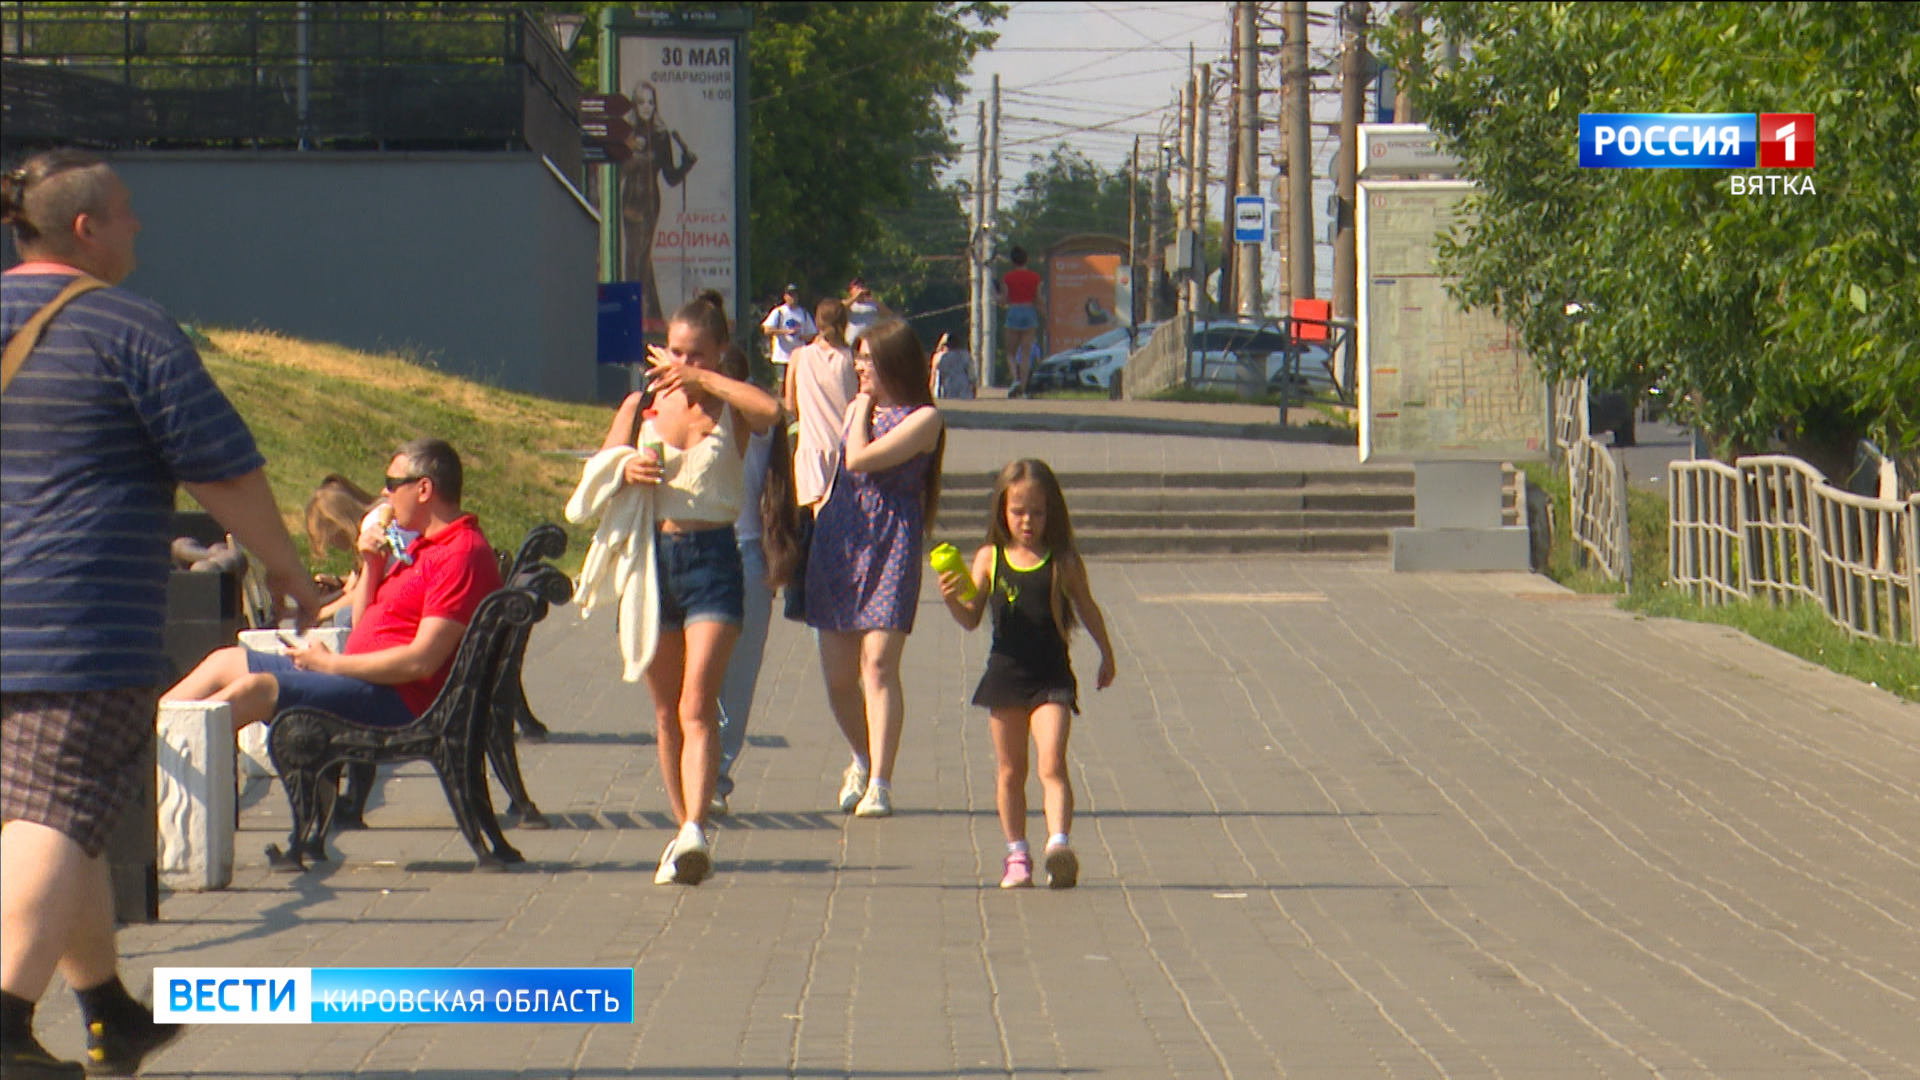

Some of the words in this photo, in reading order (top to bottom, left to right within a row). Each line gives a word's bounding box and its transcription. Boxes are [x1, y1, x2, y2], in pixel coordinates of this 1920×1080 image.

[662, 47, 683, 66] 30
[689, 47, 730, 66] МАЯ
[651, 71, 732, 83] ФИЛАРМОНИЯ
[676, 213, 728, 224] ЛАРИСА
[655, 231, 731, 248] ДОЛИНА
